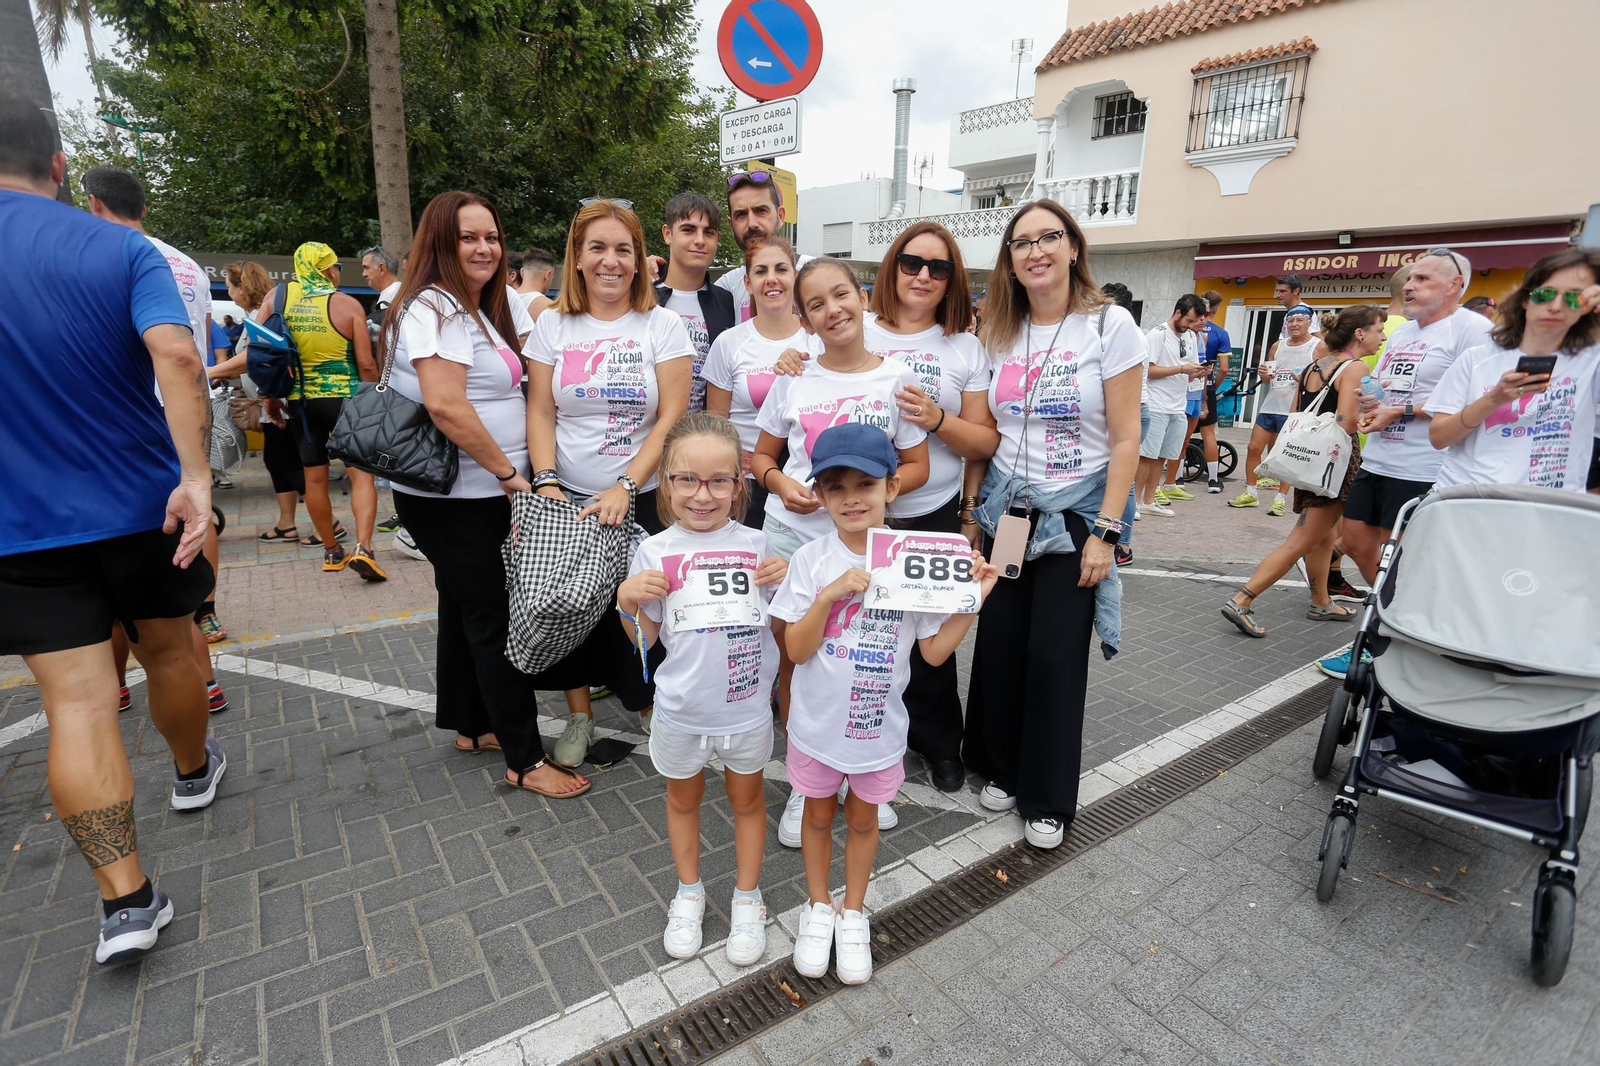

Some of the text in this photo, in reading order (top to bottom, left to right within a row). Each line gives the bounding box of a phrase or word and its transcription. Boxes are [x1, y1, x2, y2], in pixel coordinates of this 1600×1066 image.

[726, 106, 792, 128] EXCEPTO CARGA
[732, 122, 784, 140] Y DESCARGA
[726, 146, 735, 156] DE
[1283, 255, 1359, 270] ASADOR
[1341, 285, 1357, 293] DE
[1360, 284, 1391, 292] PESC
[290, 324, 327, 333] ARREÑOS
[610, 339, 641, 354] AMOR
[905, 353, 940, 363] AMOR
[746, 366, 774, 374] valore
[1389, 363, 1415, 375] 162
[575, 387, 647, 398] SONRISA
[854, 400, 890, 416] AMOR
[1011, 403, 1081, 416] SONRISA
[1501, 421, 1572, 438] SONRISA
[1282, 449, 1310, 462] Français
[1285, 442, 1320, 456] Santillana
[904, 555, 973, 582] 689
[708, 572, 749, 596] 59
[859, 630, 898, 644] FUERZA
[826, 643, 895, 664] SONRISA
[728, 655, 761, 669] Deporte
[850, 692, 886, 704] Deporte
